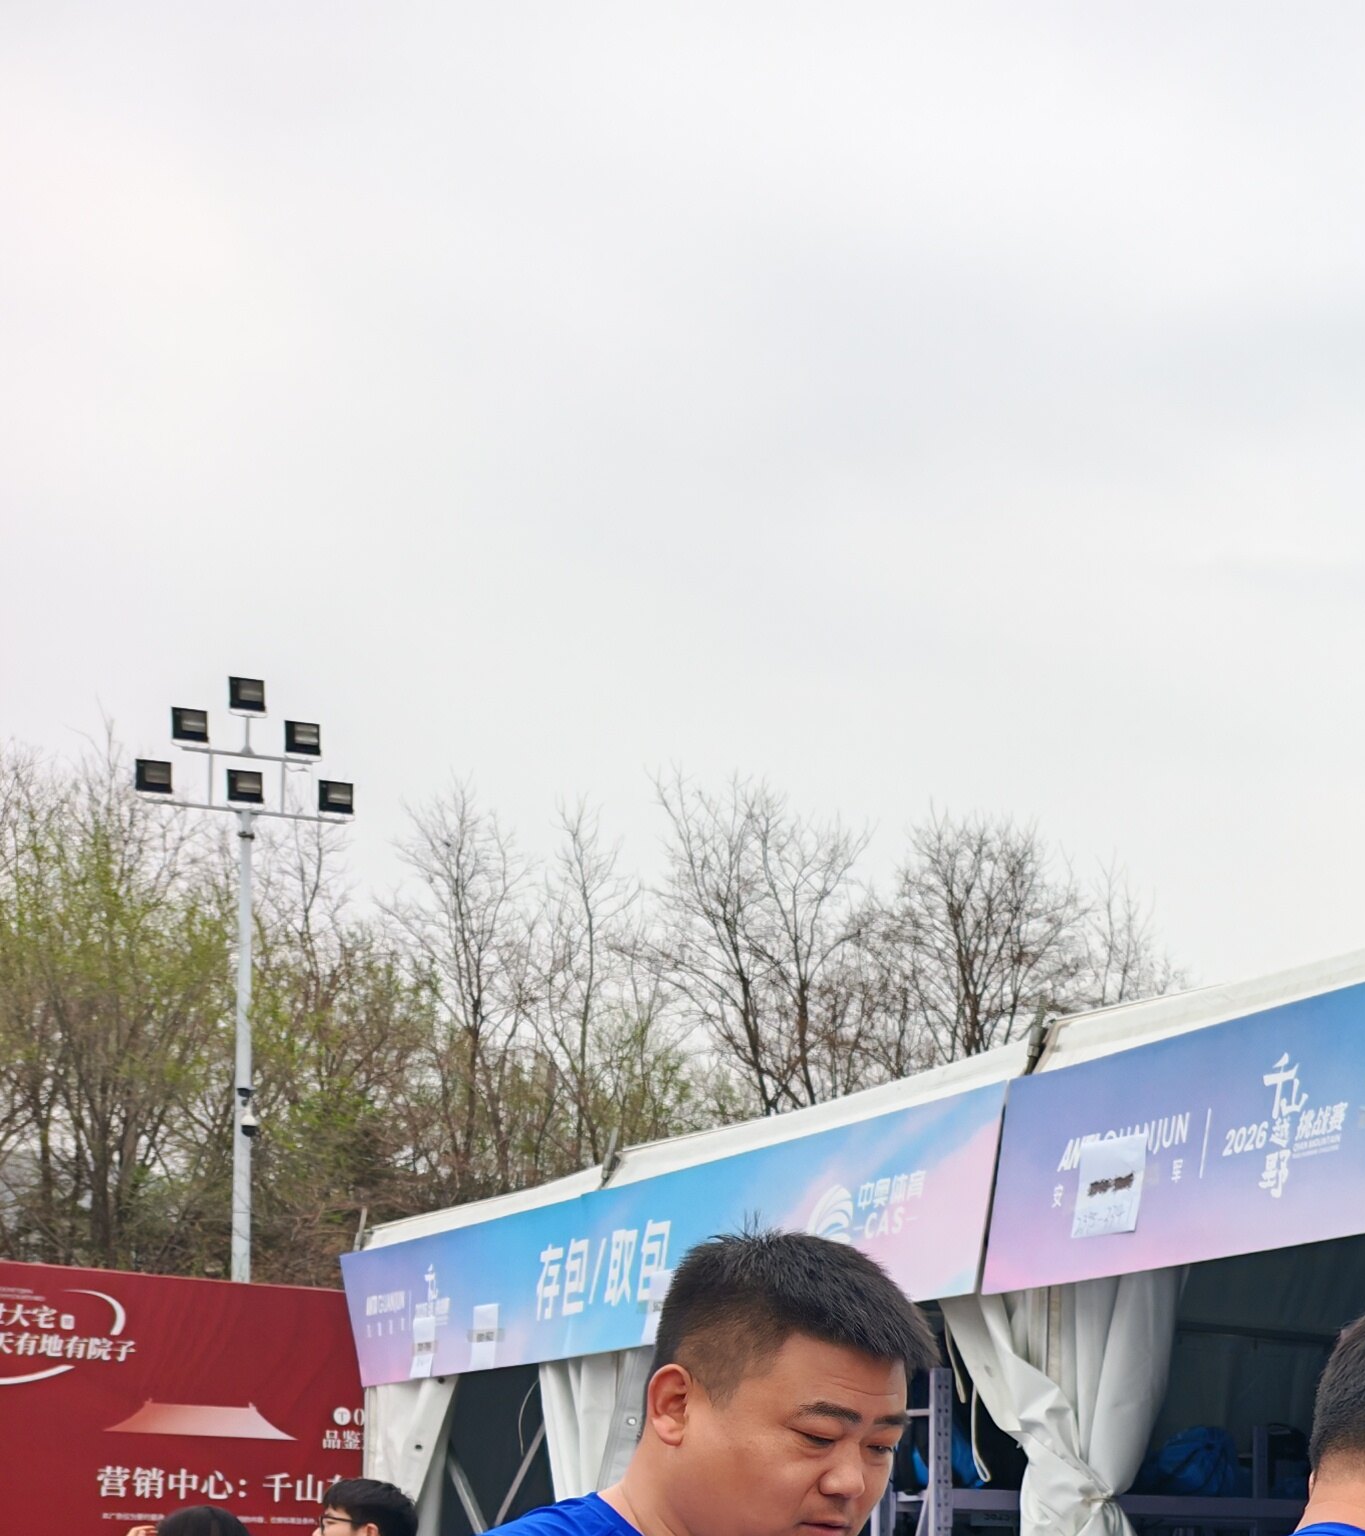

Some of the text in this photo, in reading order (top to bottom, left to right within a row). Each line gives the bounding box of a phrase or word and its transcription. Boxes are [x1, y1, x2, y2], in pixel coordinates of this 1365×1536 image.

[1222, 1120, 1269, 1157] 2026
[323, 1430, 364, 1450] 品鉴
[97, 1465, 340, 1504] 营销中心：千山
